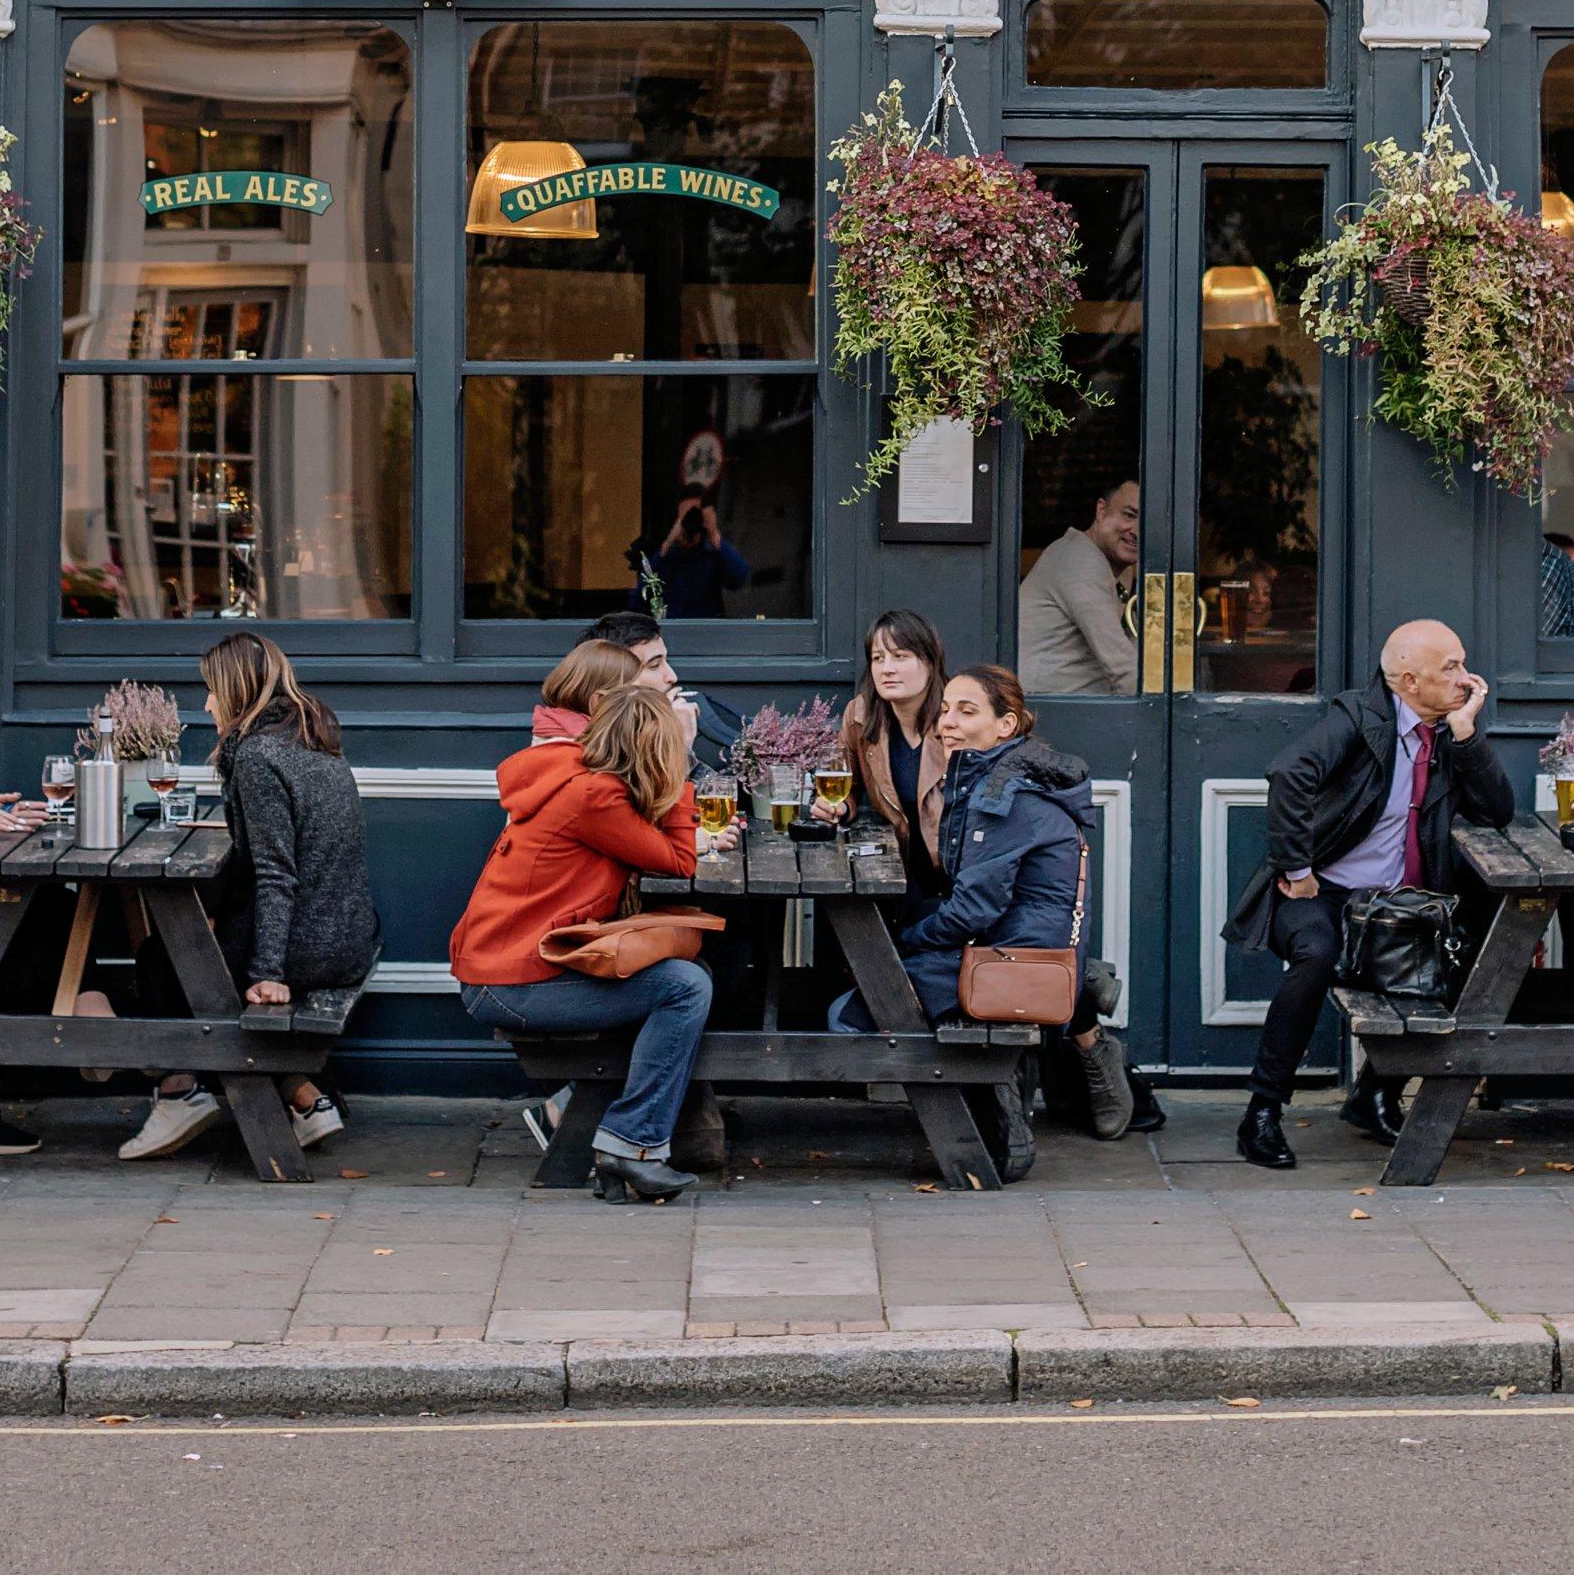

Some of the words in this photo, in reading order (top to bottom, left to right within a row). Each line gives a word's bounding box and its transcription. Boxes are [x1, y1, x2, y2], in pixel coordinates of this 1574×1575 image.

[153, 175, 231, 208] REAL
[244, 175, 319, 208] ALES
[516, 167, 667, 212] QUAFFABLE
[680, 169, 763, 209] WINES
